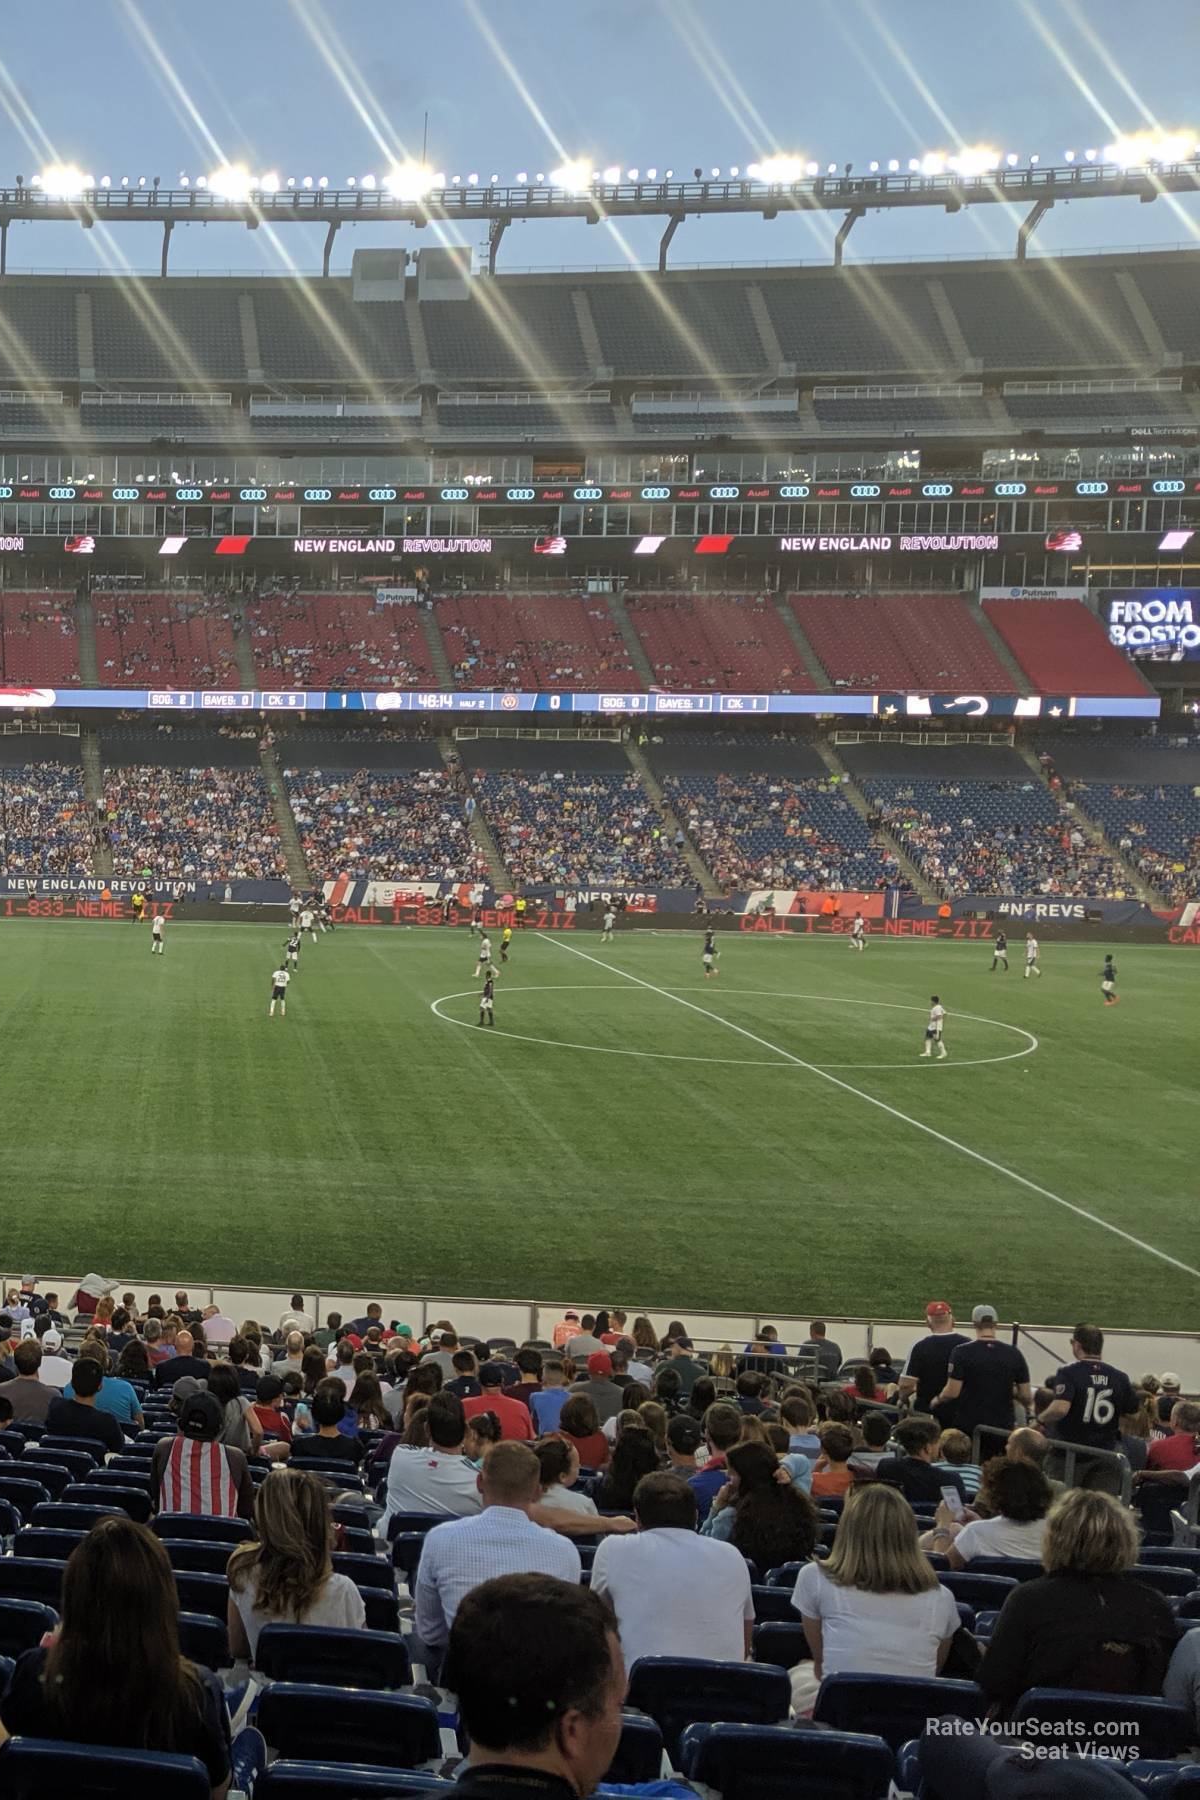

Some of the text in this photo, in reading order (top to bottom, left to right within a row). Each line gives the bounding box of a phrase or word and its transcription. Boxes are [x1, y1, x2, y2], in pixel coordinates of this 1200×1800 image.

[146, 491, 166, 500] Audi
[210, 491, 230, 500] Audi
[275, 491, 294, 500] Audi
[340, 492, 360, 500] Audi
[404, 491, 425, 500] Audi
[476, 491, 497, 499] Audi
[543, 491, 563, 499] Audi
[610, 491, 631, 499] Audi
[678, 490, 700, 498] Audi
[747, 489, 769, 497] Audi
[816, 488, 840, 496] Audi
[889, 487, 912, 496] Audi
[960, 486, 984, 495] Audi
[1034, 486, 1057, 495] Audi
[1118, 484, 1141, 492] Audi
[294, 539, 491, 552] NEW ENGLAND REVOLUTION
[781, 536, 998, 550] NEW ENGLAND REVOLUTION
[1022, 589, 1057, 597] Putnam
[1110, 600, 1192, 622] FROM
[204, 695, 248, 705] SAVES: 0
[269, 695, 283, 705] CK:
[341, 694, 347, 708] 1
[550, 696, 560, 709] 0
[603, 698, 639, 708] SOG: 0
[659, 699, 693, 708] SAVES:
[728, 699, 743, 708] CK:
[8, 879, 196, 892] NEW ENGLAND REVOUTION
[332, 907, 382, 924] CALL
[741, 915, 793, 932] CALL
[1083, 1387, 1115, 1424] 16
